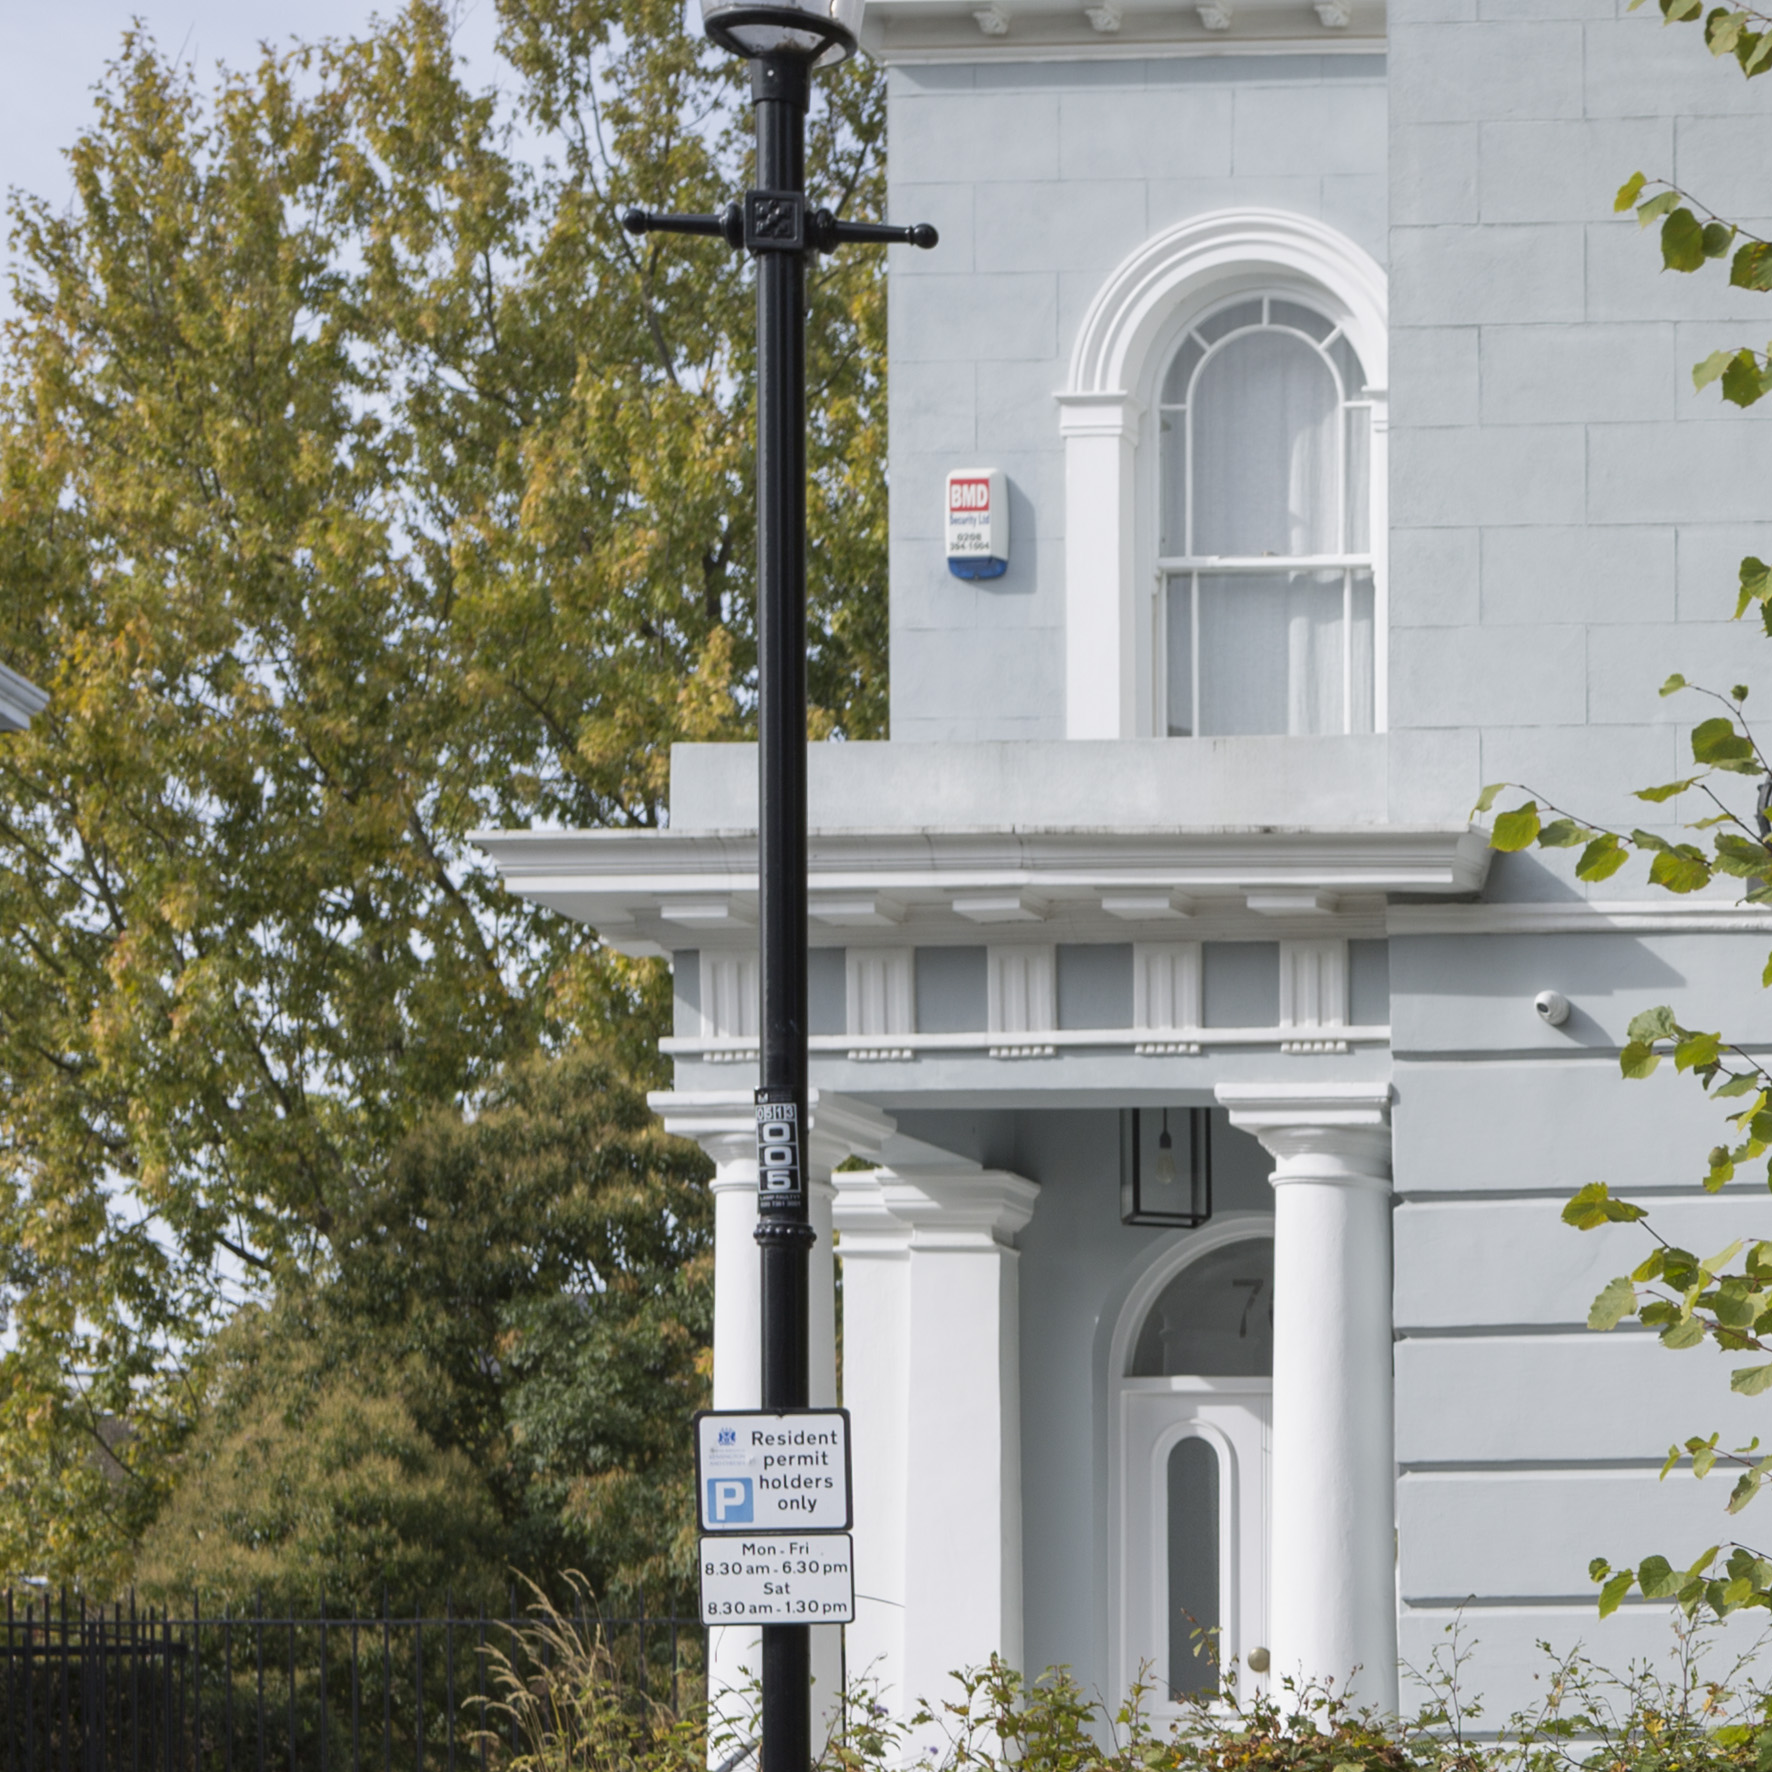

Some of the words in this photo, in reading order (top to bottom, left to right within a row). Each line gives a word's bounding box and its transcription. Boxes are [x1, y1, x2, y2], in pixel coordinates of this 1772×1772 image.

[951, 483, 988, 508] BMD
[1233, 1279, 1273, 1338] 7
[752, 1430, 838, 1446] Resident
[764, 1451, 829, 1470] permit
[759, 1474, 834, 1489] holders
[715, 1481, 745, 1520] P
[777, 1495, 817, 1513] only
[742, 1543, 776, 1556] Mon
[789, 1542, 809, 1555] Fri
[705, 1562, 742, 1575] 8.30
[746, 1564, 770, 1575] am
[782, 1561, 819, 1574] 6.30
[823, 1563, 848, 1576] pm
[763, 1582, 791, 1595] Sat
[708, 1602, 745, 1615] 8.30
[749, 1604, 773, 1614] am
[786, 1600, 819, 1614] 1.30
[823, 1603, 847, 1615] pm
